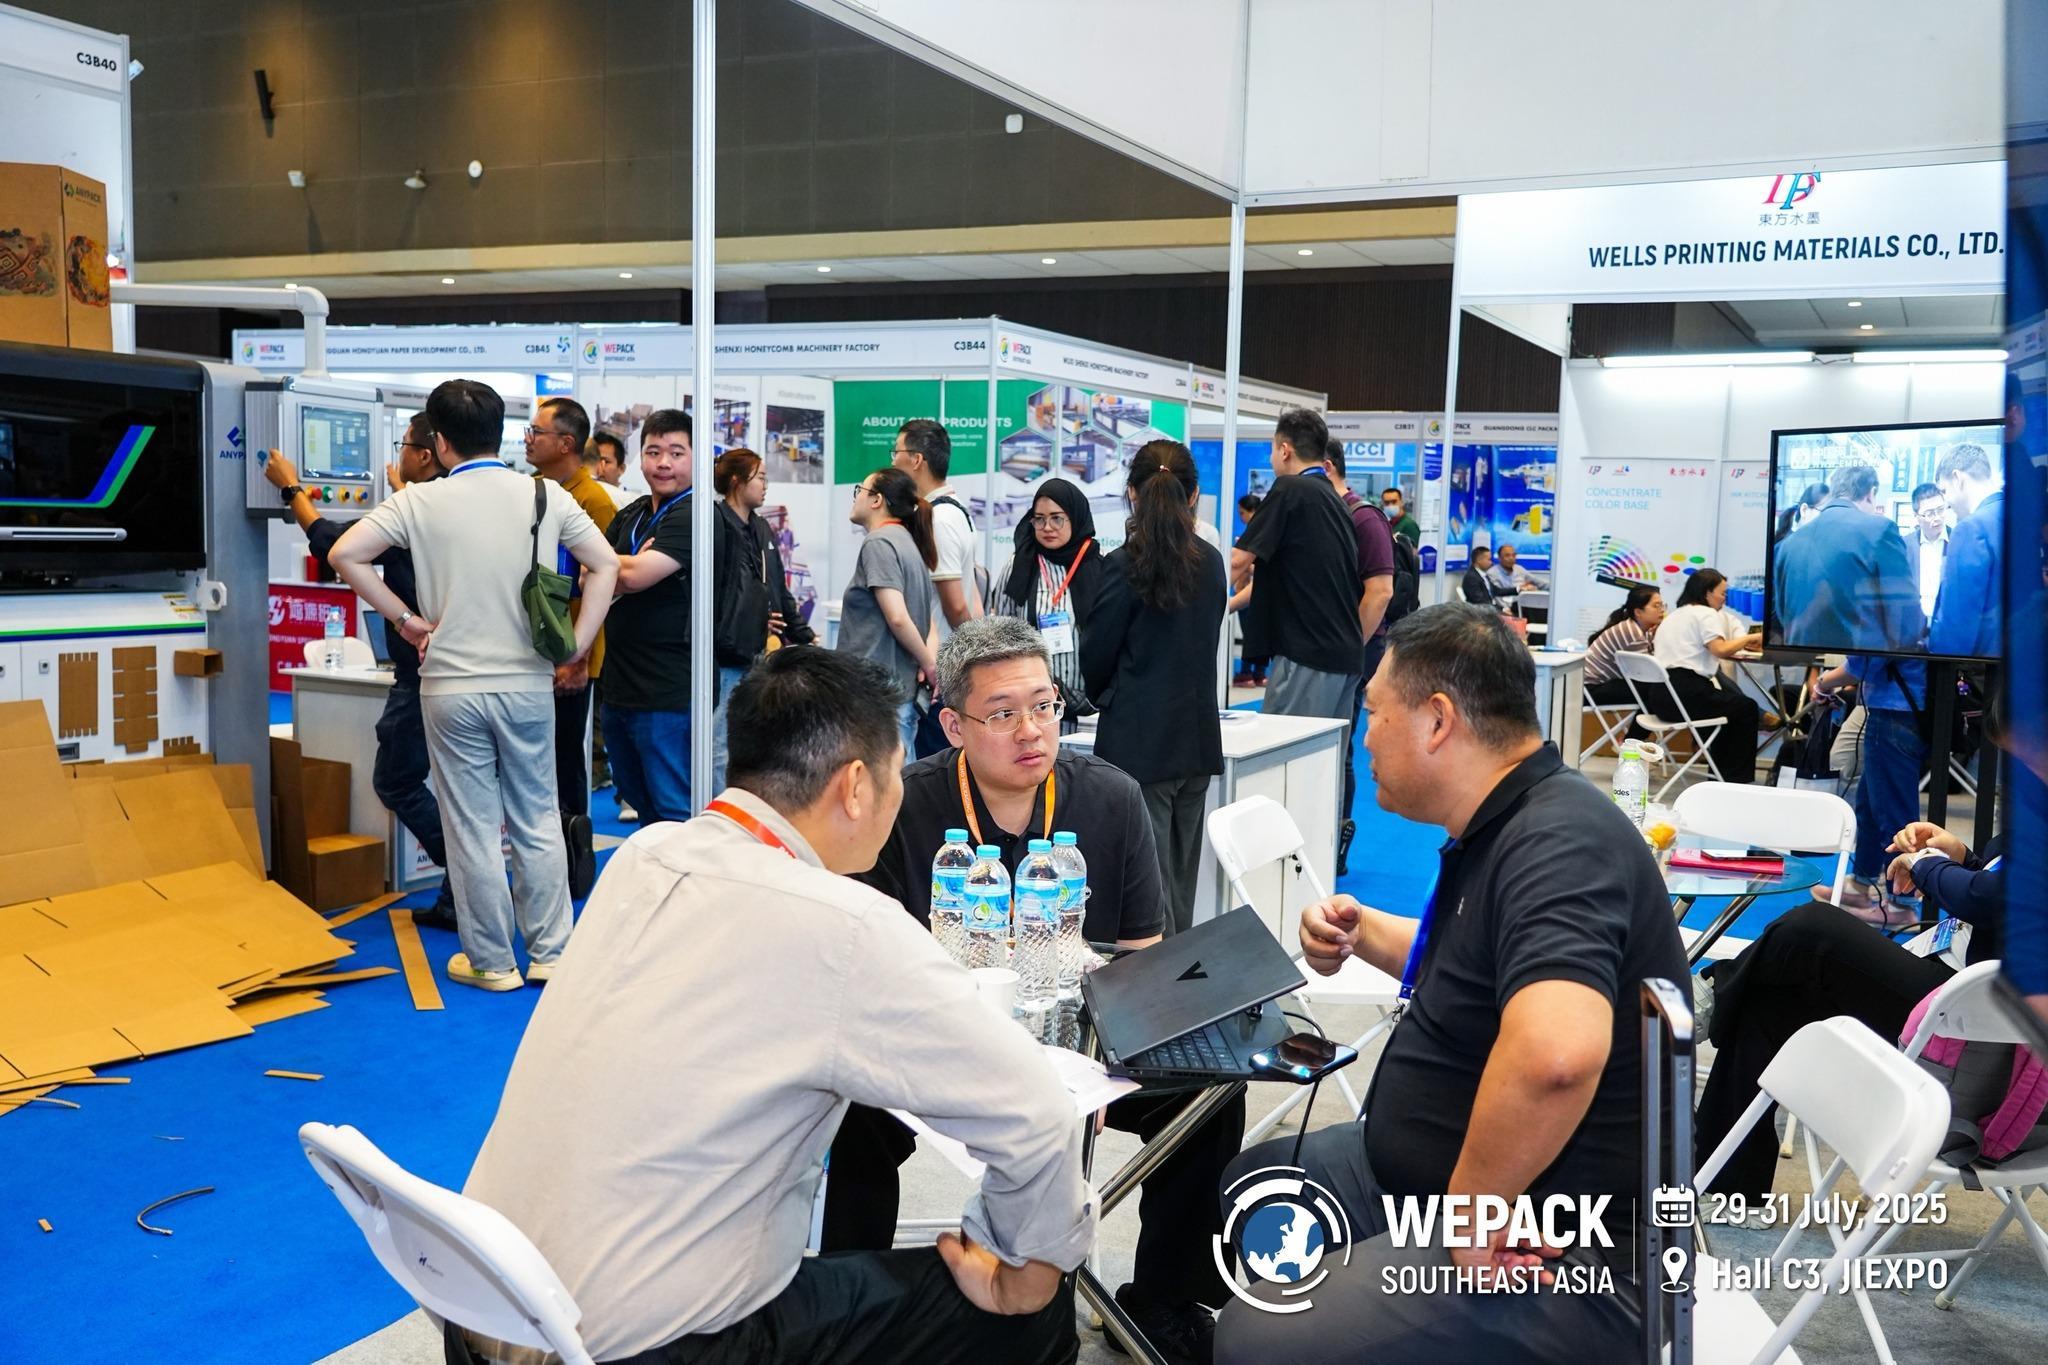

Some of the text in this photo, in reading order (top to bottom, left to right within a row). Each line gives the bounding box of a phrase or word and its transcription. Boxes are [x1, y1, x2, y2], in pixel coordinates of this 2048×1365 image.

[77, 52, 116, 71] C3B40
[1759, 211, 1821, 227] 東方水墨
[1588, 231, 2005, 269] WELLS PRINTING MATERIALS CO., LTD.
[412, 346, 457, 355] DEVELOPMENT
[474, 345, 487, 354] LTD.
[525, 344, 551, 354] C3B45
[604, 344, 635, 353] WEPACK
[714, 343, 880, 354] SHENXI HONEYCOMB MACHINERY FACTORY
[954, 341, 986, 351] C3B44
[862, 417, 904, 427] ABOUT
[944, 418, 1013, 428] PRODUTS
[1586, 487, 1662, 498] CONCENTRATE
[1585, 499, 1650, 510] COLOR BASE
